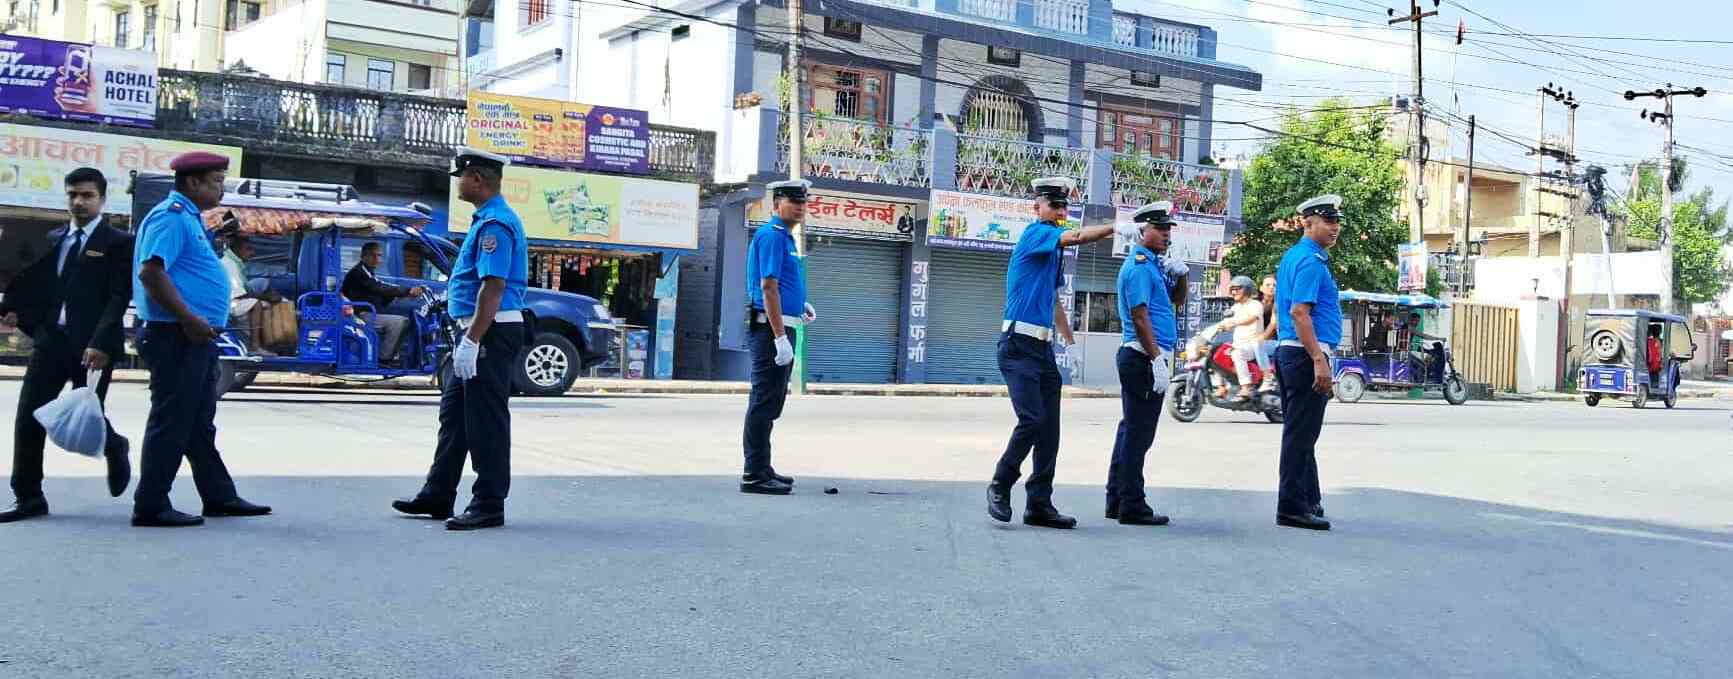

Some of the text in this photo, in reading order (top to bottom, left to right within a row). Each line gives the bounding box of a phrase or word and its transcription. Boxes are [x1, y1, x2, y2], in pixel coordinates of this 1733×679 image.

[104, 69, 156, 88] ACHAL
[104, 86, 153, 104] HOTEL
[470, 119, 529, 130] ORIGINAL
[480, 131, 518, 139] ENERGY
[806, 197, 897, 225] ईन टेलर्स
